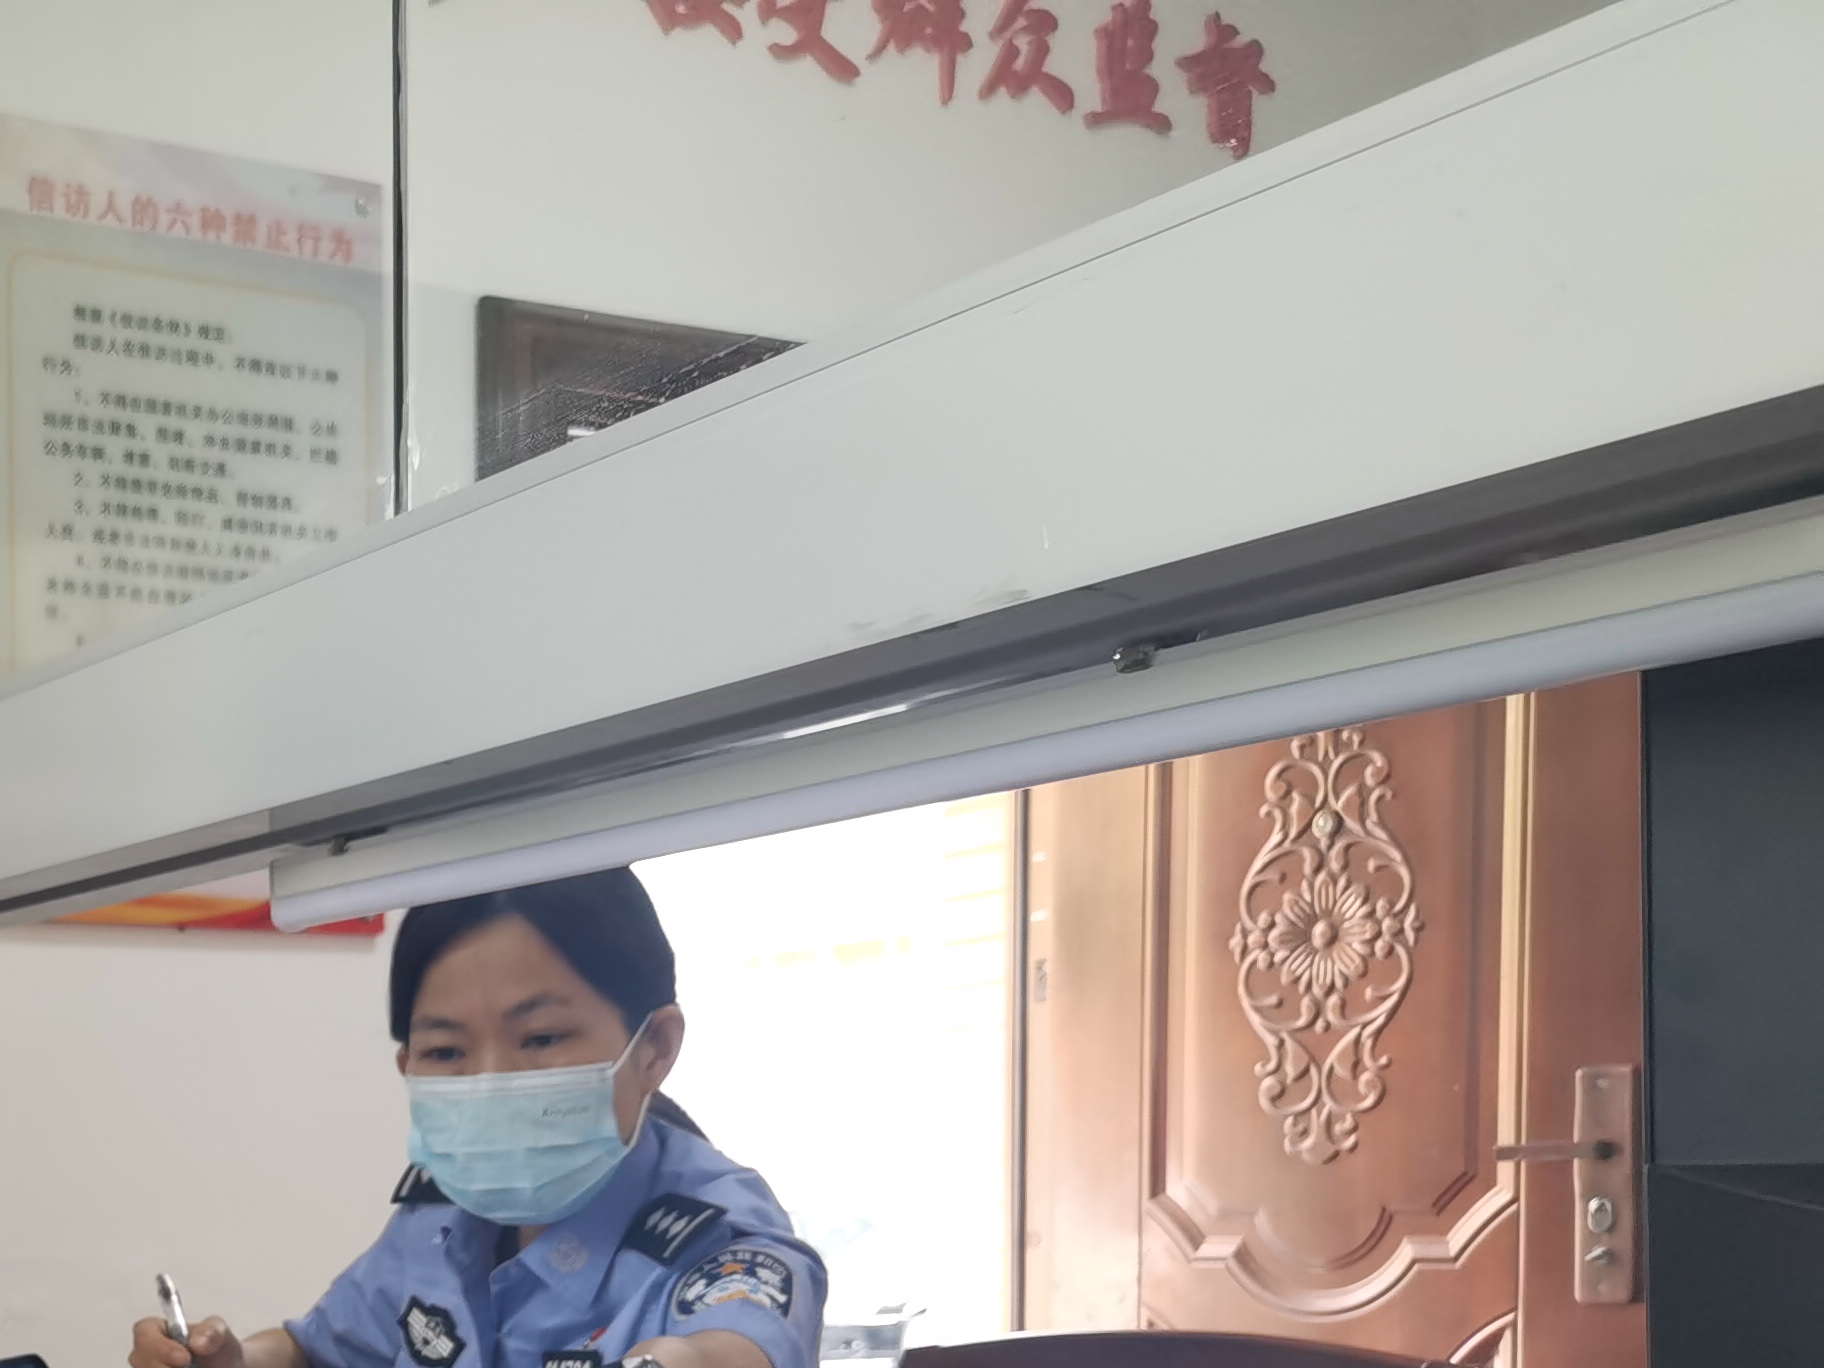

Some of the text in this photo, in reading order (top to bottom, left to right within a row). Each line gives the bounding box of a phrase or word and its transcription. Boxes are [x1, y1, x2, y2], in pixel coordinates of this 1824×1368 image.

[28, 177, 354, 262] 信访人的六种禁止行为
